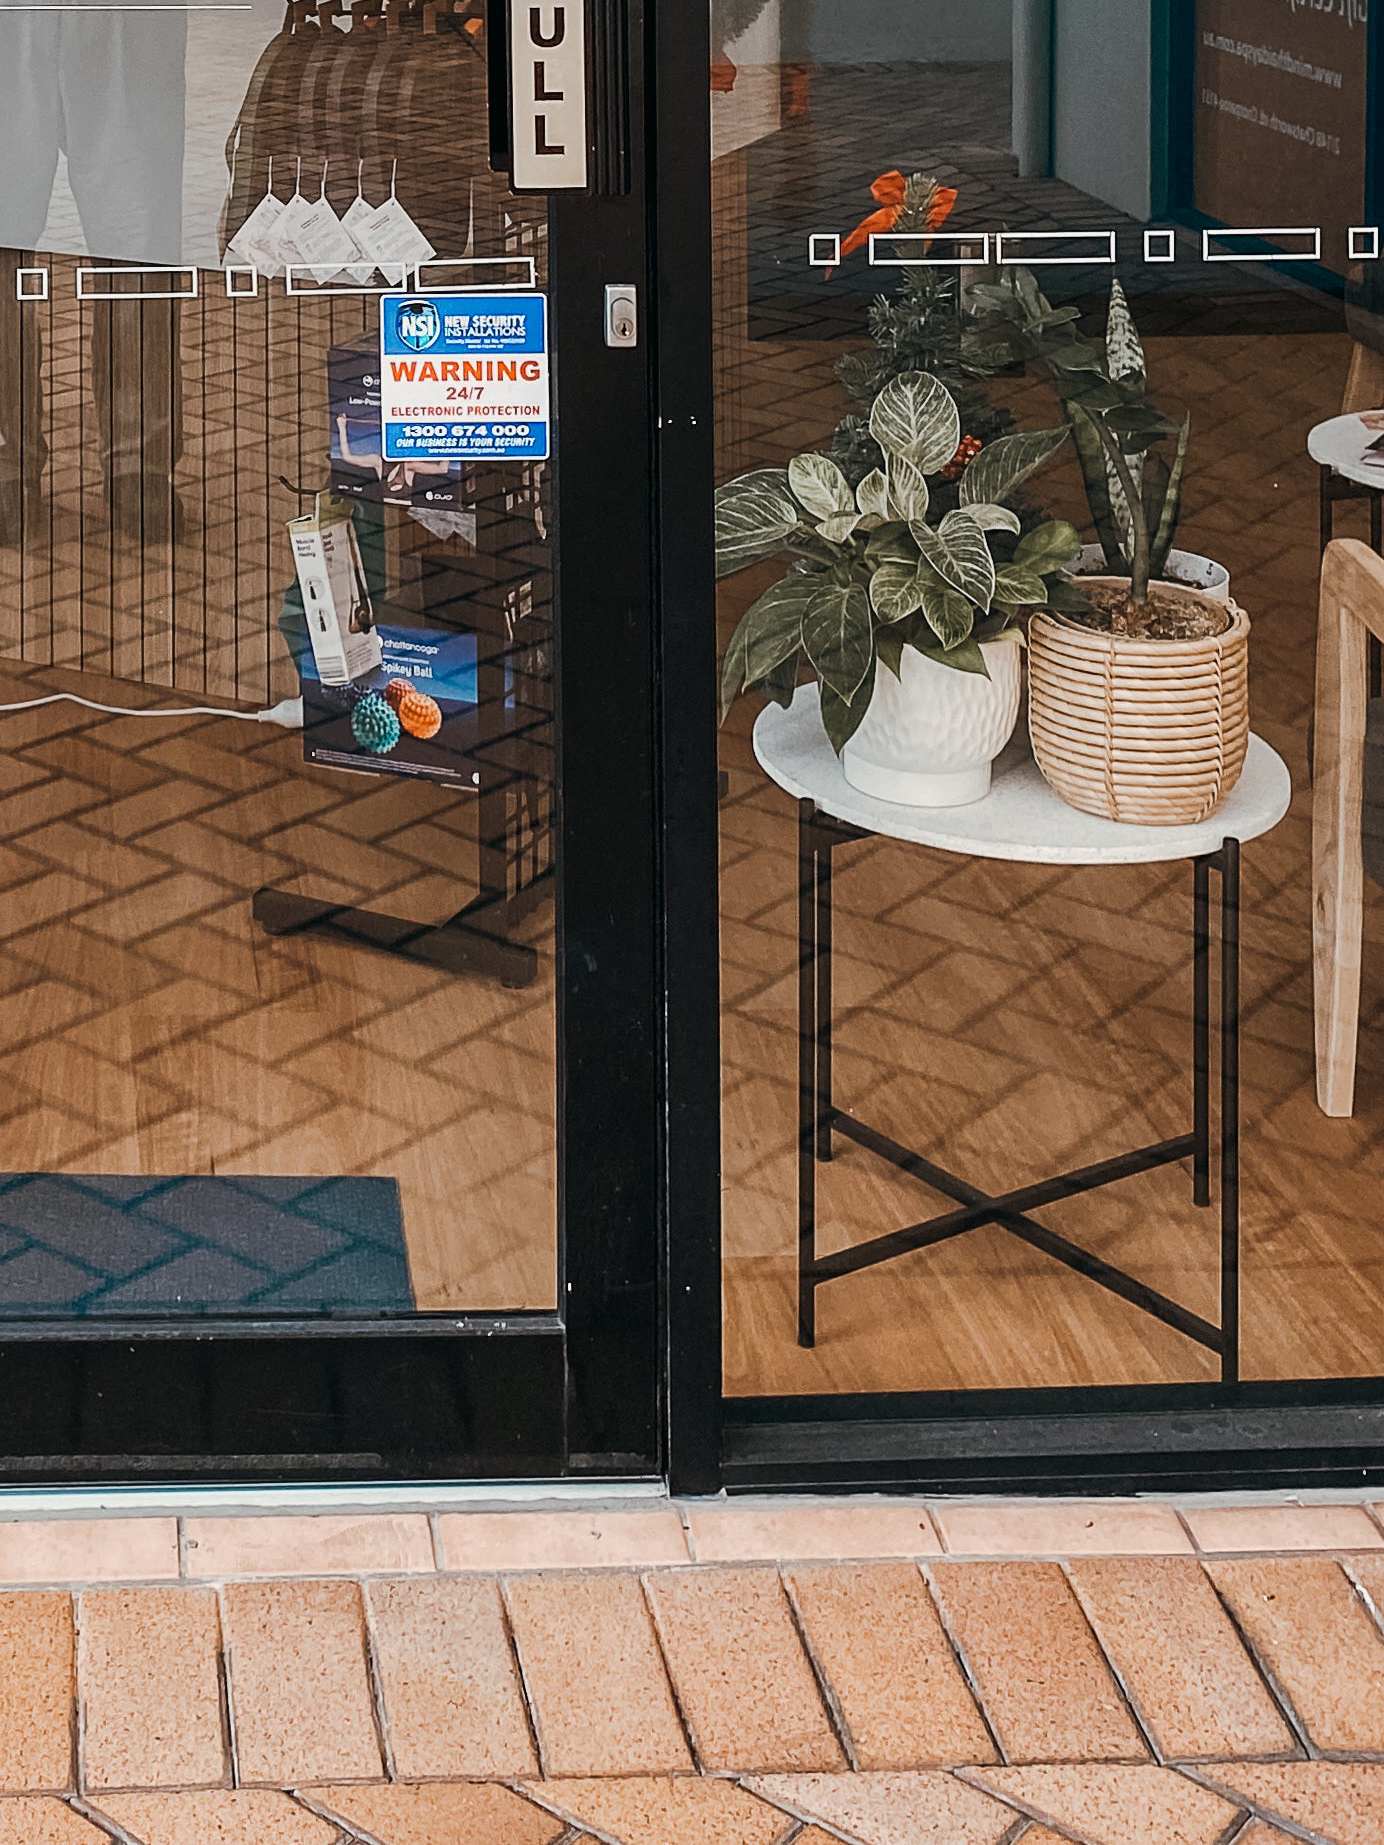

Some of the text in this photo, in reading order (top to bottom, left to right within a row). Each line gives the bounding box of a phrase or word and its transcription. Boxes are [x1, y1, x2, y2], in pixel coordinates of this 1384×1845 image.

[401, 315, 434, 337] NSI
[444, 314, 526, 327] NEW SECURITY
[444, 326, 526, 337] INSTALLATIONS
[389, 360, 541, 382] WARNING
[445, 386, 485, 400] 24/7
[391, 405, 541, 417] ELECTRONIC PROTECTION
[402, 425, 530, 437] 1300 674 000
[416, 438, 457, 447] BUSINESS
[458, 438, 468, 447] IS
[469, 438, 493, 447] YOUR
[494, 437, 536, 447] SECURITY
